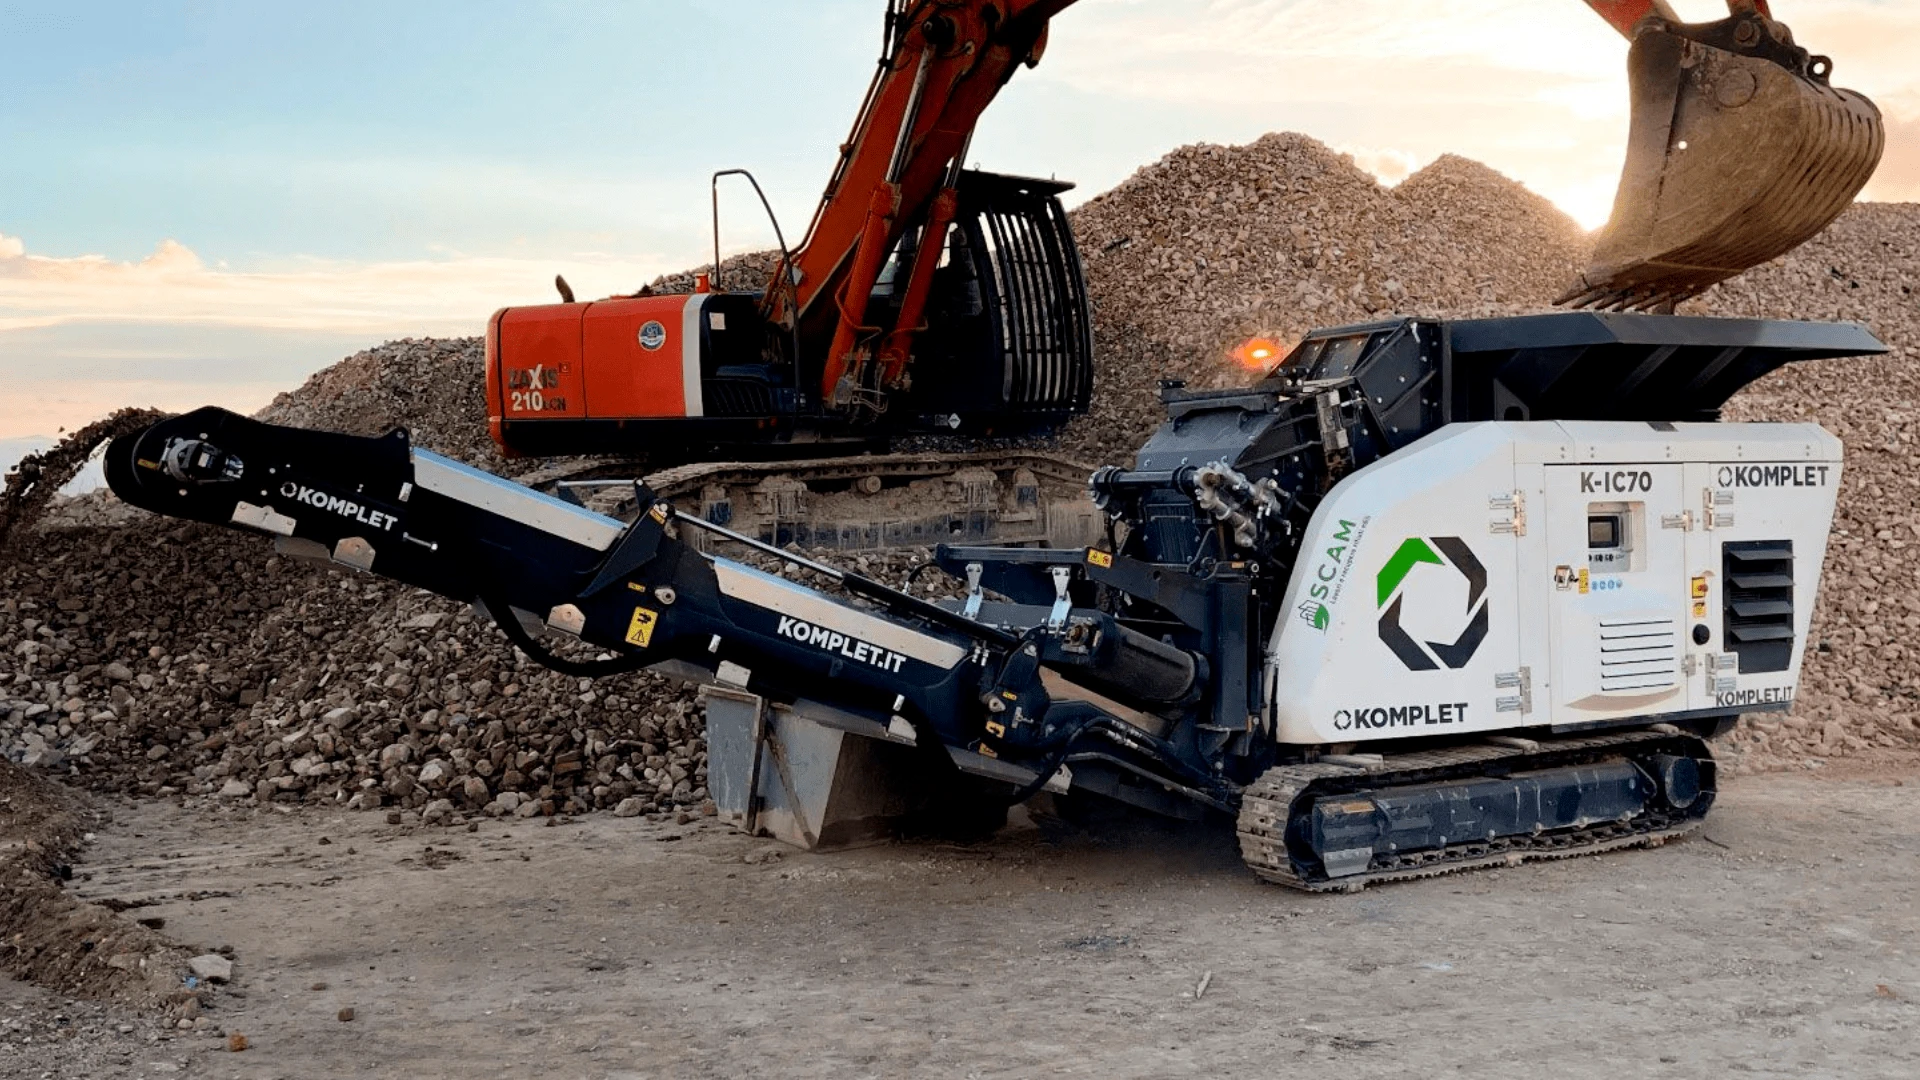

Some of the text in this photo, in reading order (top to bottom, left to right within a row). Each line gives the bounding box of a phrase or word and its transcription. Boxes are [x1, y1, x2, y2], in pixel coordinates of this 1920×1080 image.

[508, 364, 558, 389] ZAXIS
[1580, 471, 1652, 493] K-IC70
[1735, 465, 1829, 487] KOMPLET
[297, 485, 398, 531] KOMPLET
[1310, 519, 1356, 600] SCAM
[777, 615, 907, 673] KOMPLET.IT
[1716, 686, 1793, 706] KOMPLET.IT
[1354, 702, 1468, 729] KOMPLET
